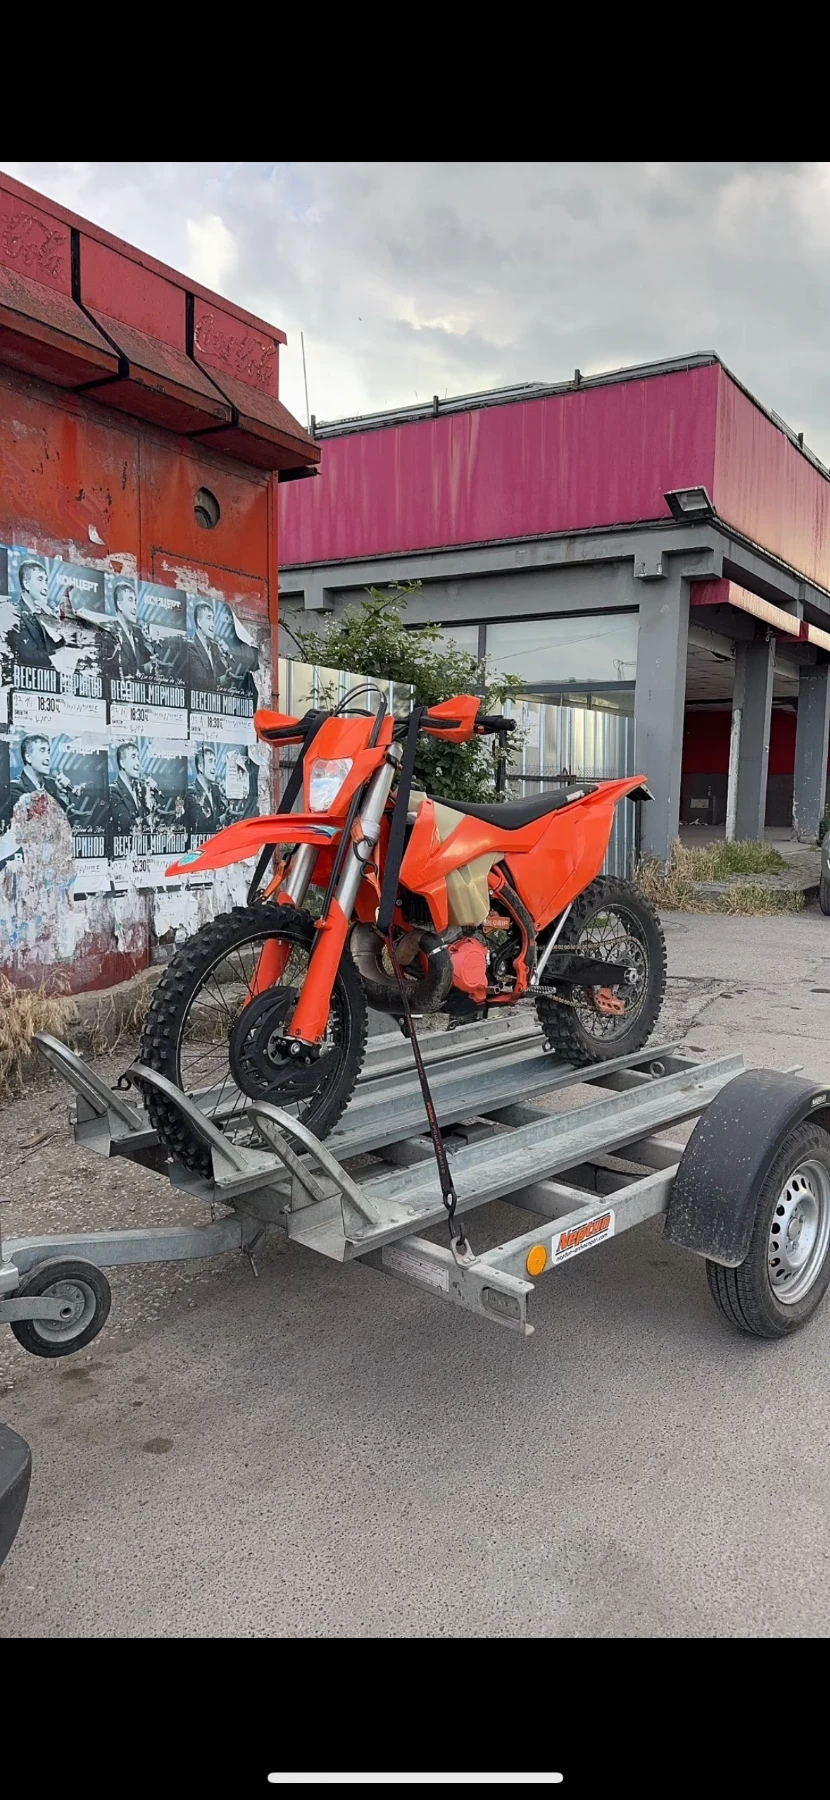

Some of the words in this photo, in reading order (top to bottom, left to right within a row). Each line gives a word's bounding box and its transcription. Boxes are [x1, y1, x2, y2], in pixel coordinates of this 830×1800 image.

[56, 573, 98, 593] КОНЦЕРТ
[13, 664, 57, 692] ВЕСЕЛИН
[149, 683, 185, 708] МАРИНОВ
[190, 689, 221, 713] ВЕСЕЛИН
[222, 695, 254, 718] МАРИНОВ
[72, 836, 105, 857] АРИНОВ
[150, 833, 186, 855] МАРИНОВ
[556, 1214, 611, 1252] Neptun
